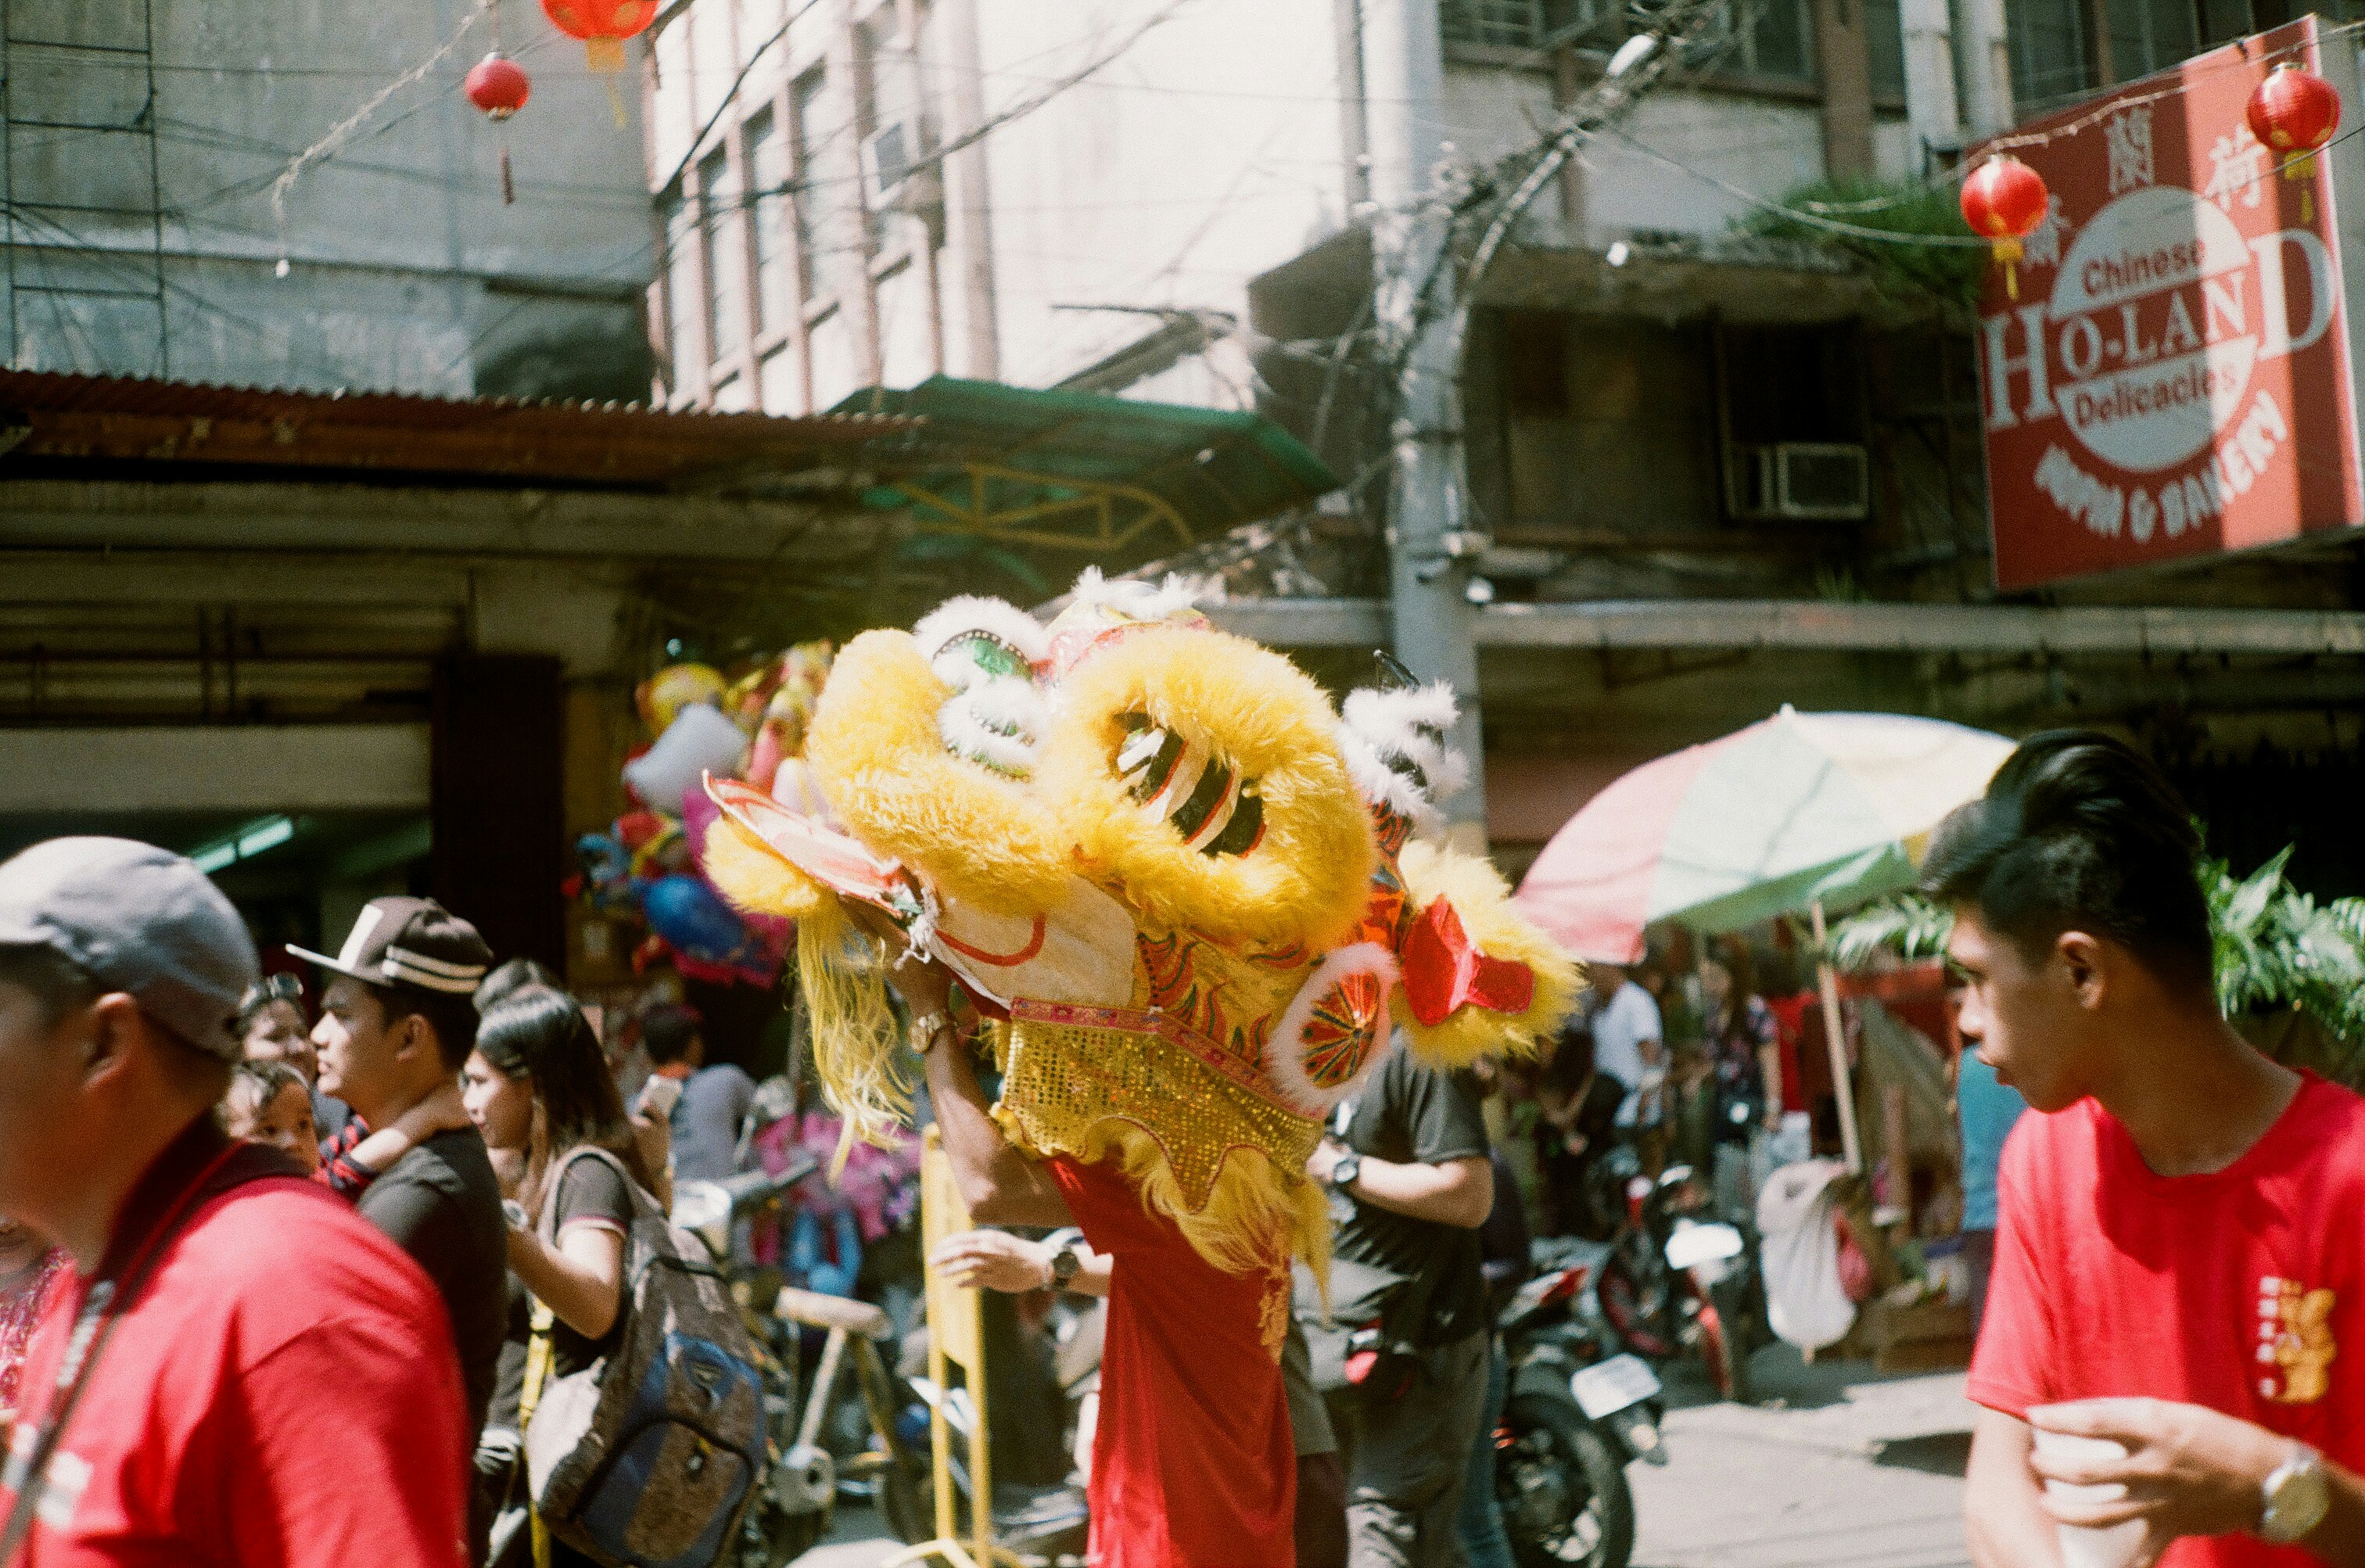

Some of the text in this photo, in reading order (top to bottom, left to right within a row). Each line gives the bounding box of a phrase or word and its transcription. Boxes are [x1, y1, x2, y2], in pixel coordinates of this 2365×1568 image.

[2082, 235, 2205, 296] Chinese
[2076, 363, 2237, 428] Delicacies
[2159, 389, 2287, 537] BAKERY
